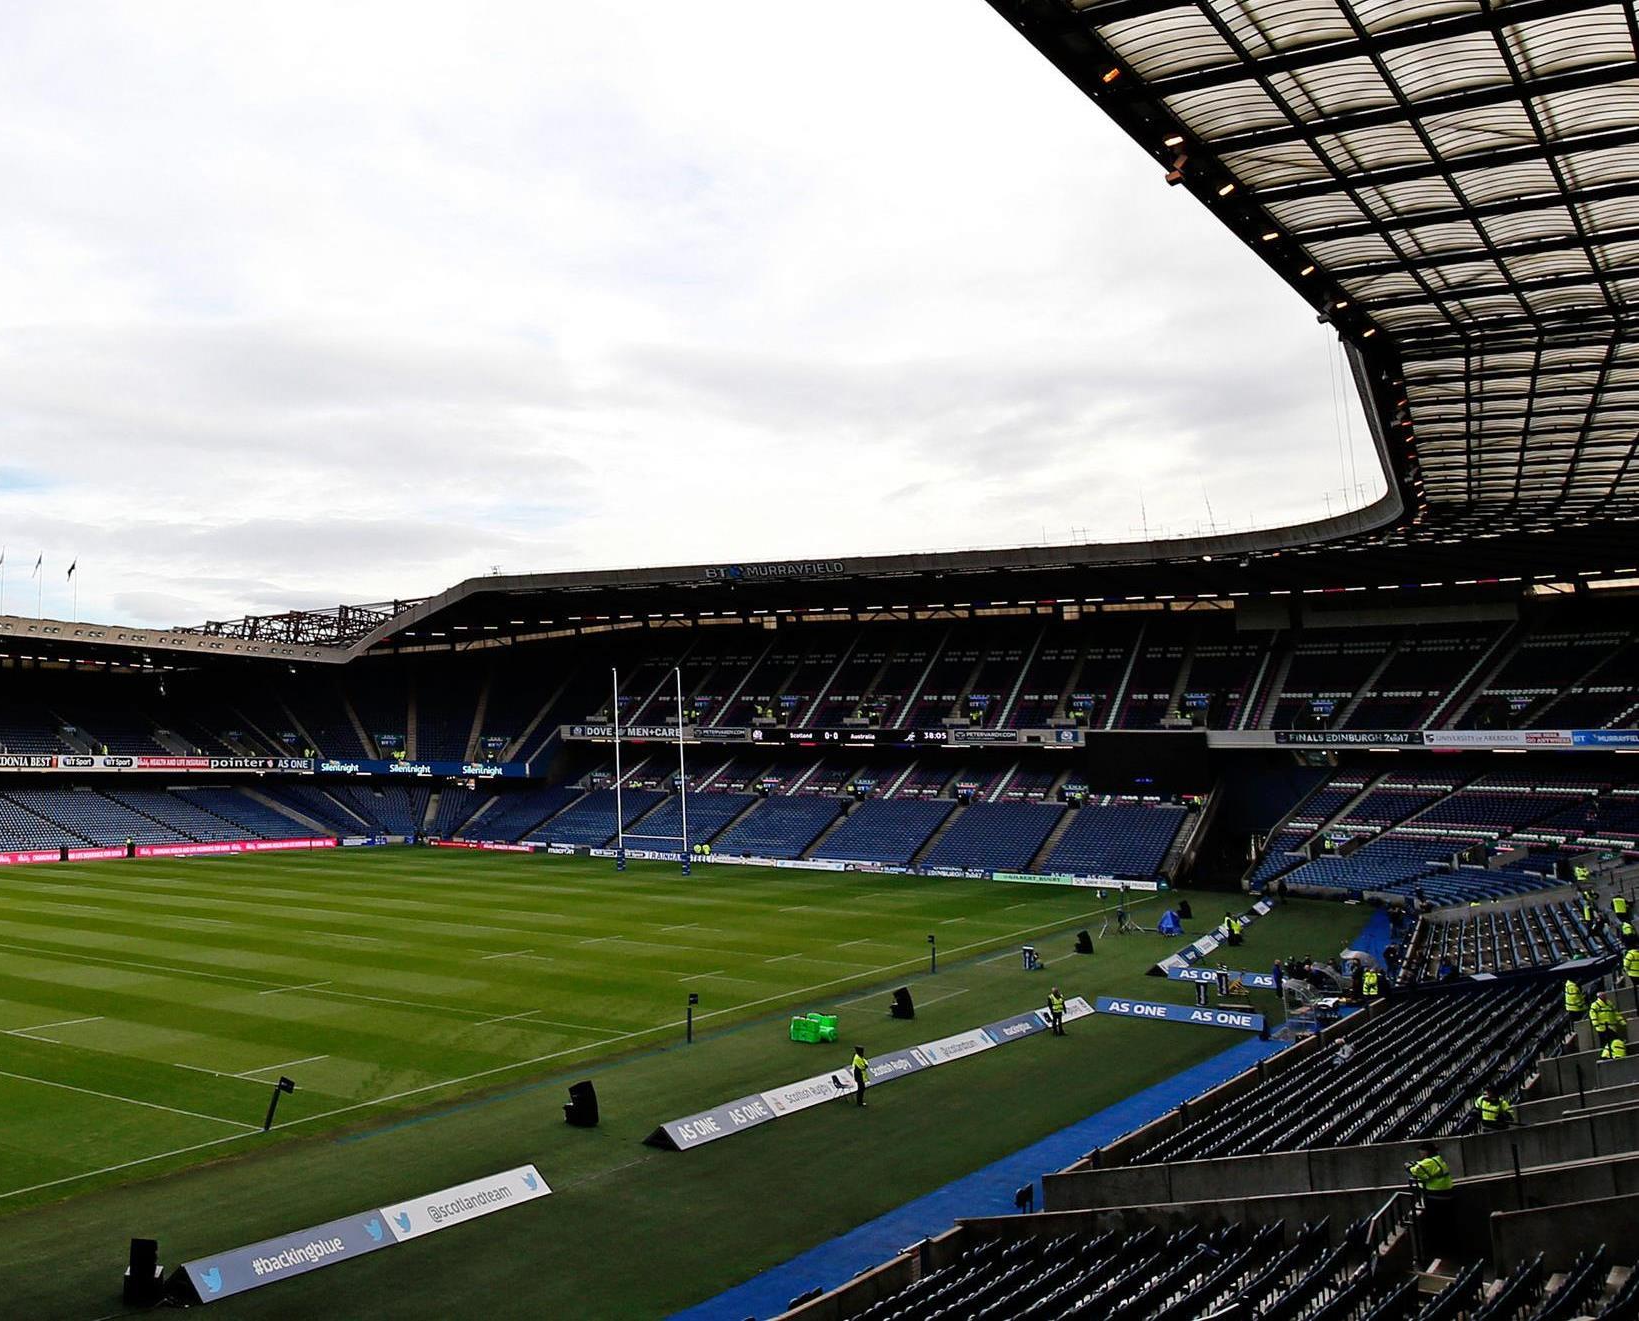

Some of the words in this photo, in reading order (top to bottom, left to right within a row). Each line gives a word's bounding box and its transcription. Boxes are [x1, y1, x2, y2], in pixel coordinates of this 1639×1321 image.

[746, 562, 844, 577] MURRAYFIELD
[587, 727, 612, 736] DOVE
[627, 728, 682, 738] MEN+CARE
[1325, 734, 1382, 743] EDINBURGH
[30, 756, 51, 767] BEST
[211, 758, 264, 770] pointer
[278, 759, 289, 768] AS
[290, 759, 308, 769] ONE
[1179, 970, 1198, 979] AS
[1109, 1001, 1131, 1014] AS
[1133, 1003, 1167, 1018] ONE
[1190, 1009, 1213, 1024] AS
[1216, 1012, 1252, 1027] ONE
[869, 1061, 893, 1077] Scottish
[893, 1057, 912, 1071] Rugby
[784, 1085, 811, 1104] Scottish
[812, 1080, 832, 1097] Rugby
[727, 1108, 745, 1126] AS
[744, 1100, 768, 1120] ONE
[677, 1123, 697, 1142] AS
[697, 1116, 722, 1137] ONE
[427, 1183, 513, 1224] @scotlandteam
[252, 1235, 346, 1277] #backingblue
